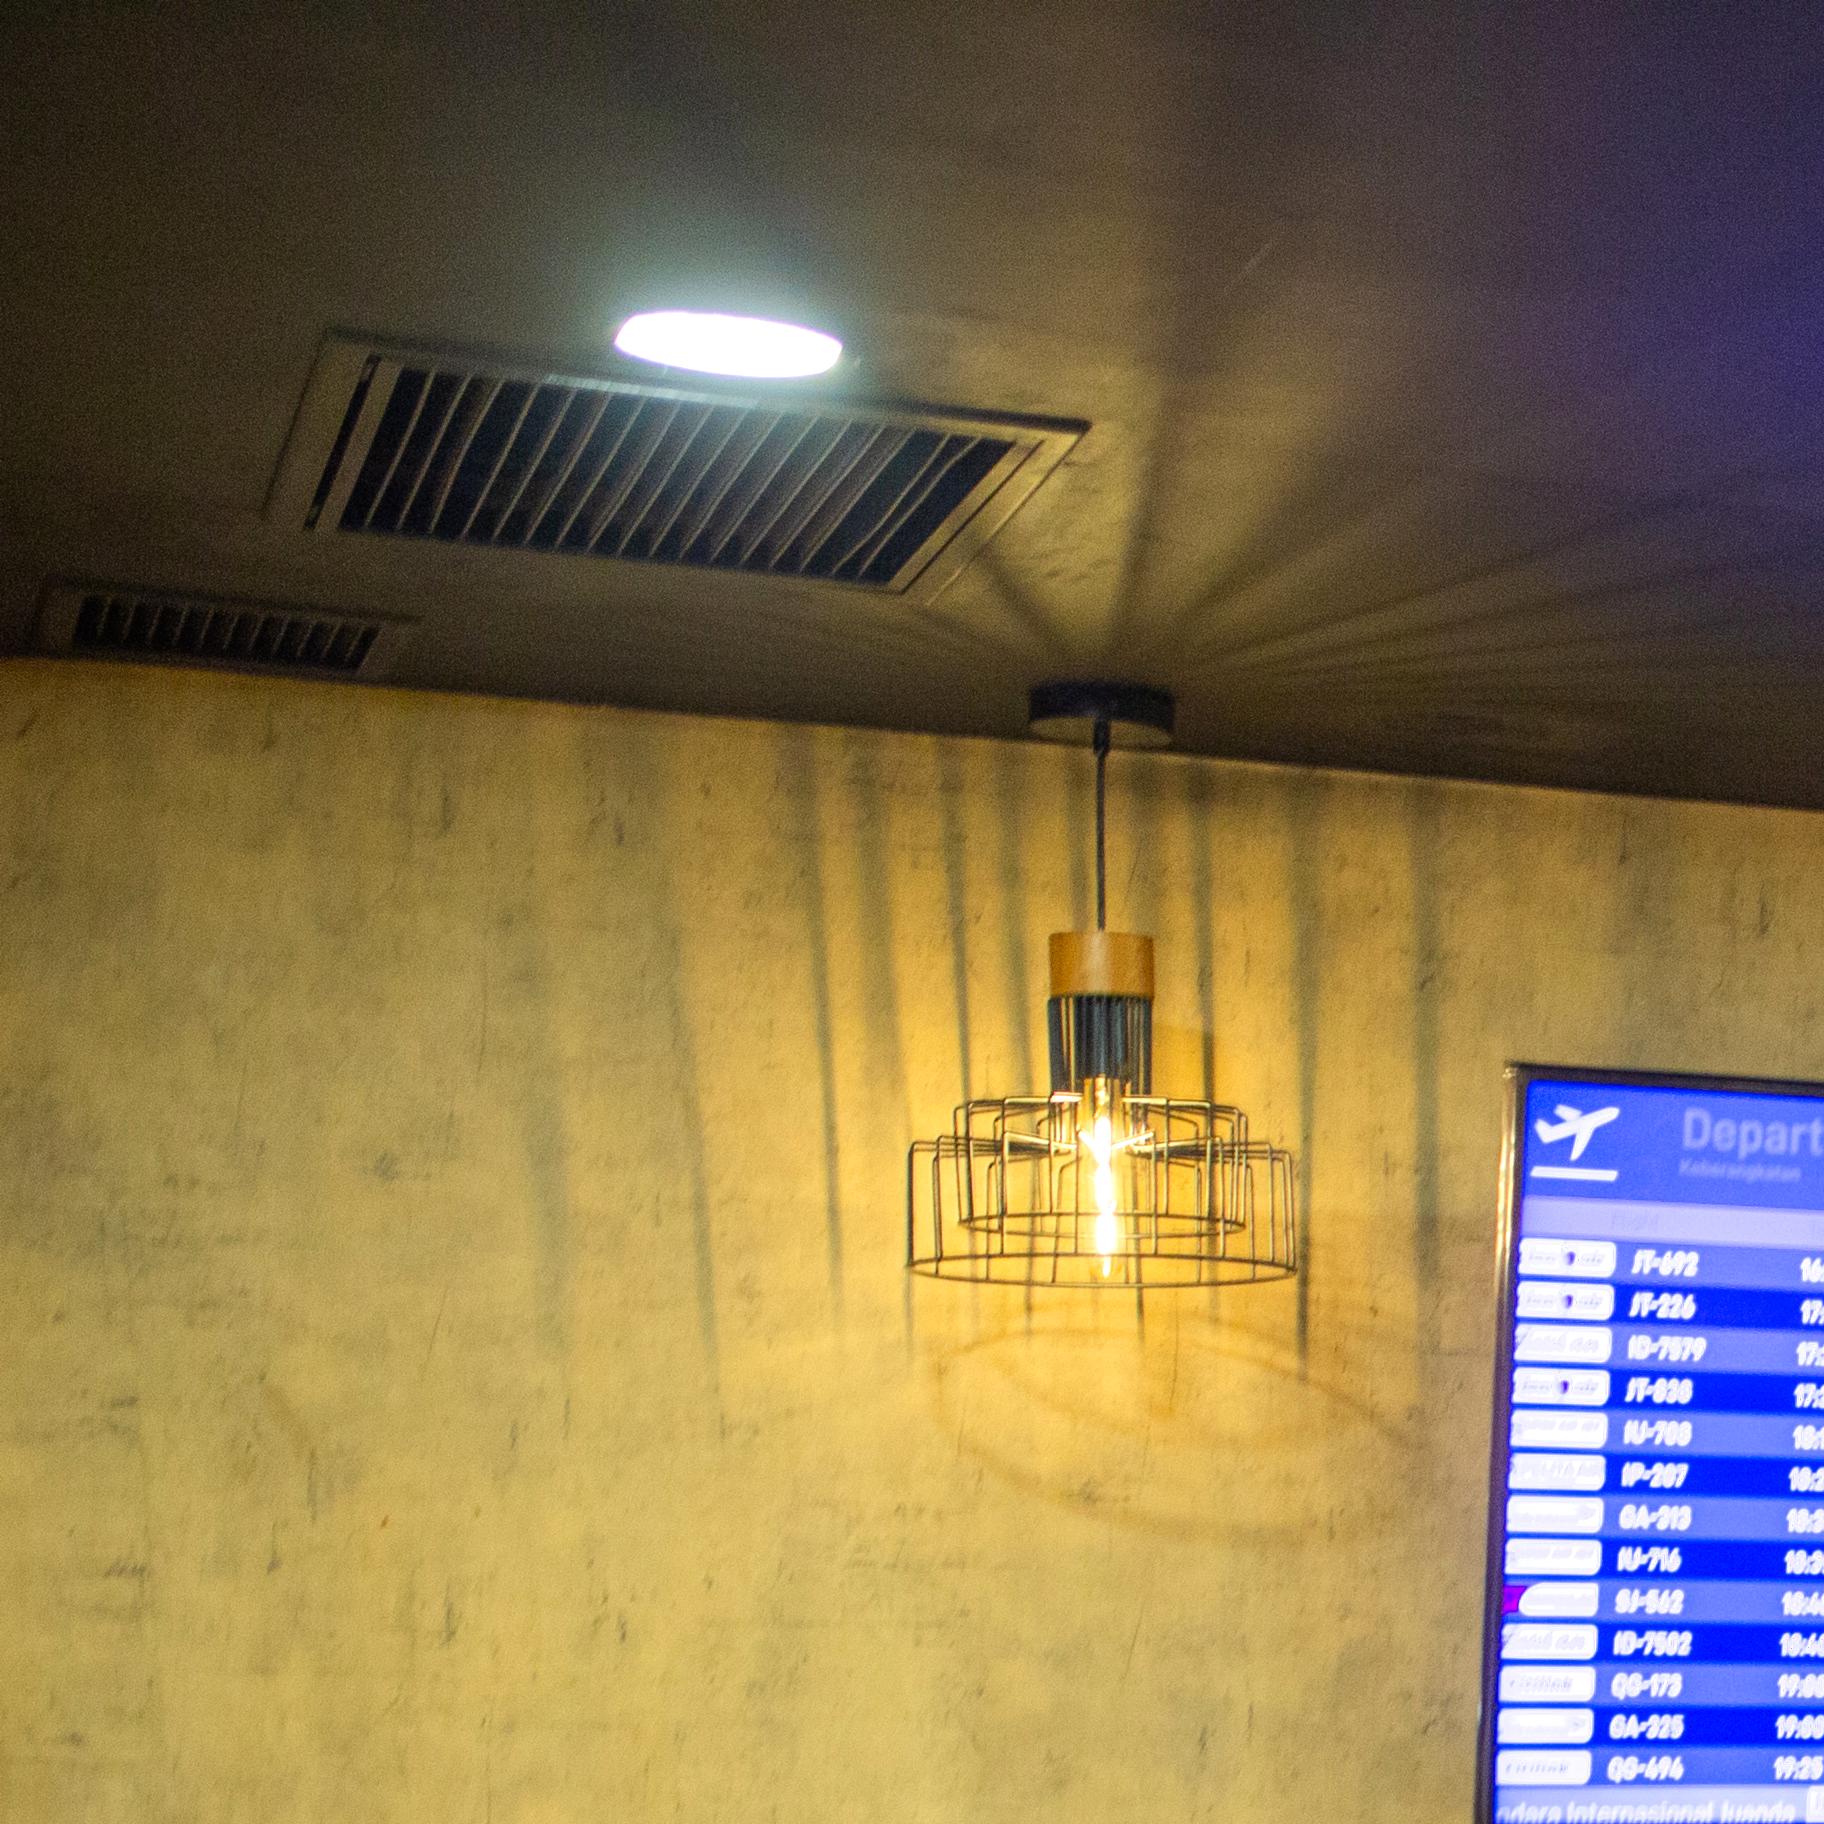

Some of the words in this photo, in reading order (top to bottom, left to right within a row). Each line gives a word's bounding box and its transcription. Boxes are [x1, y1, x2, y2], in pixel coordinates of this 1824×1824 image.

[1632, 1250, 1699, 1277] JT-692
[1629, 1292, 1696, 1319] JT-226
[1618, 1547, 1681, 1572] IU-716
